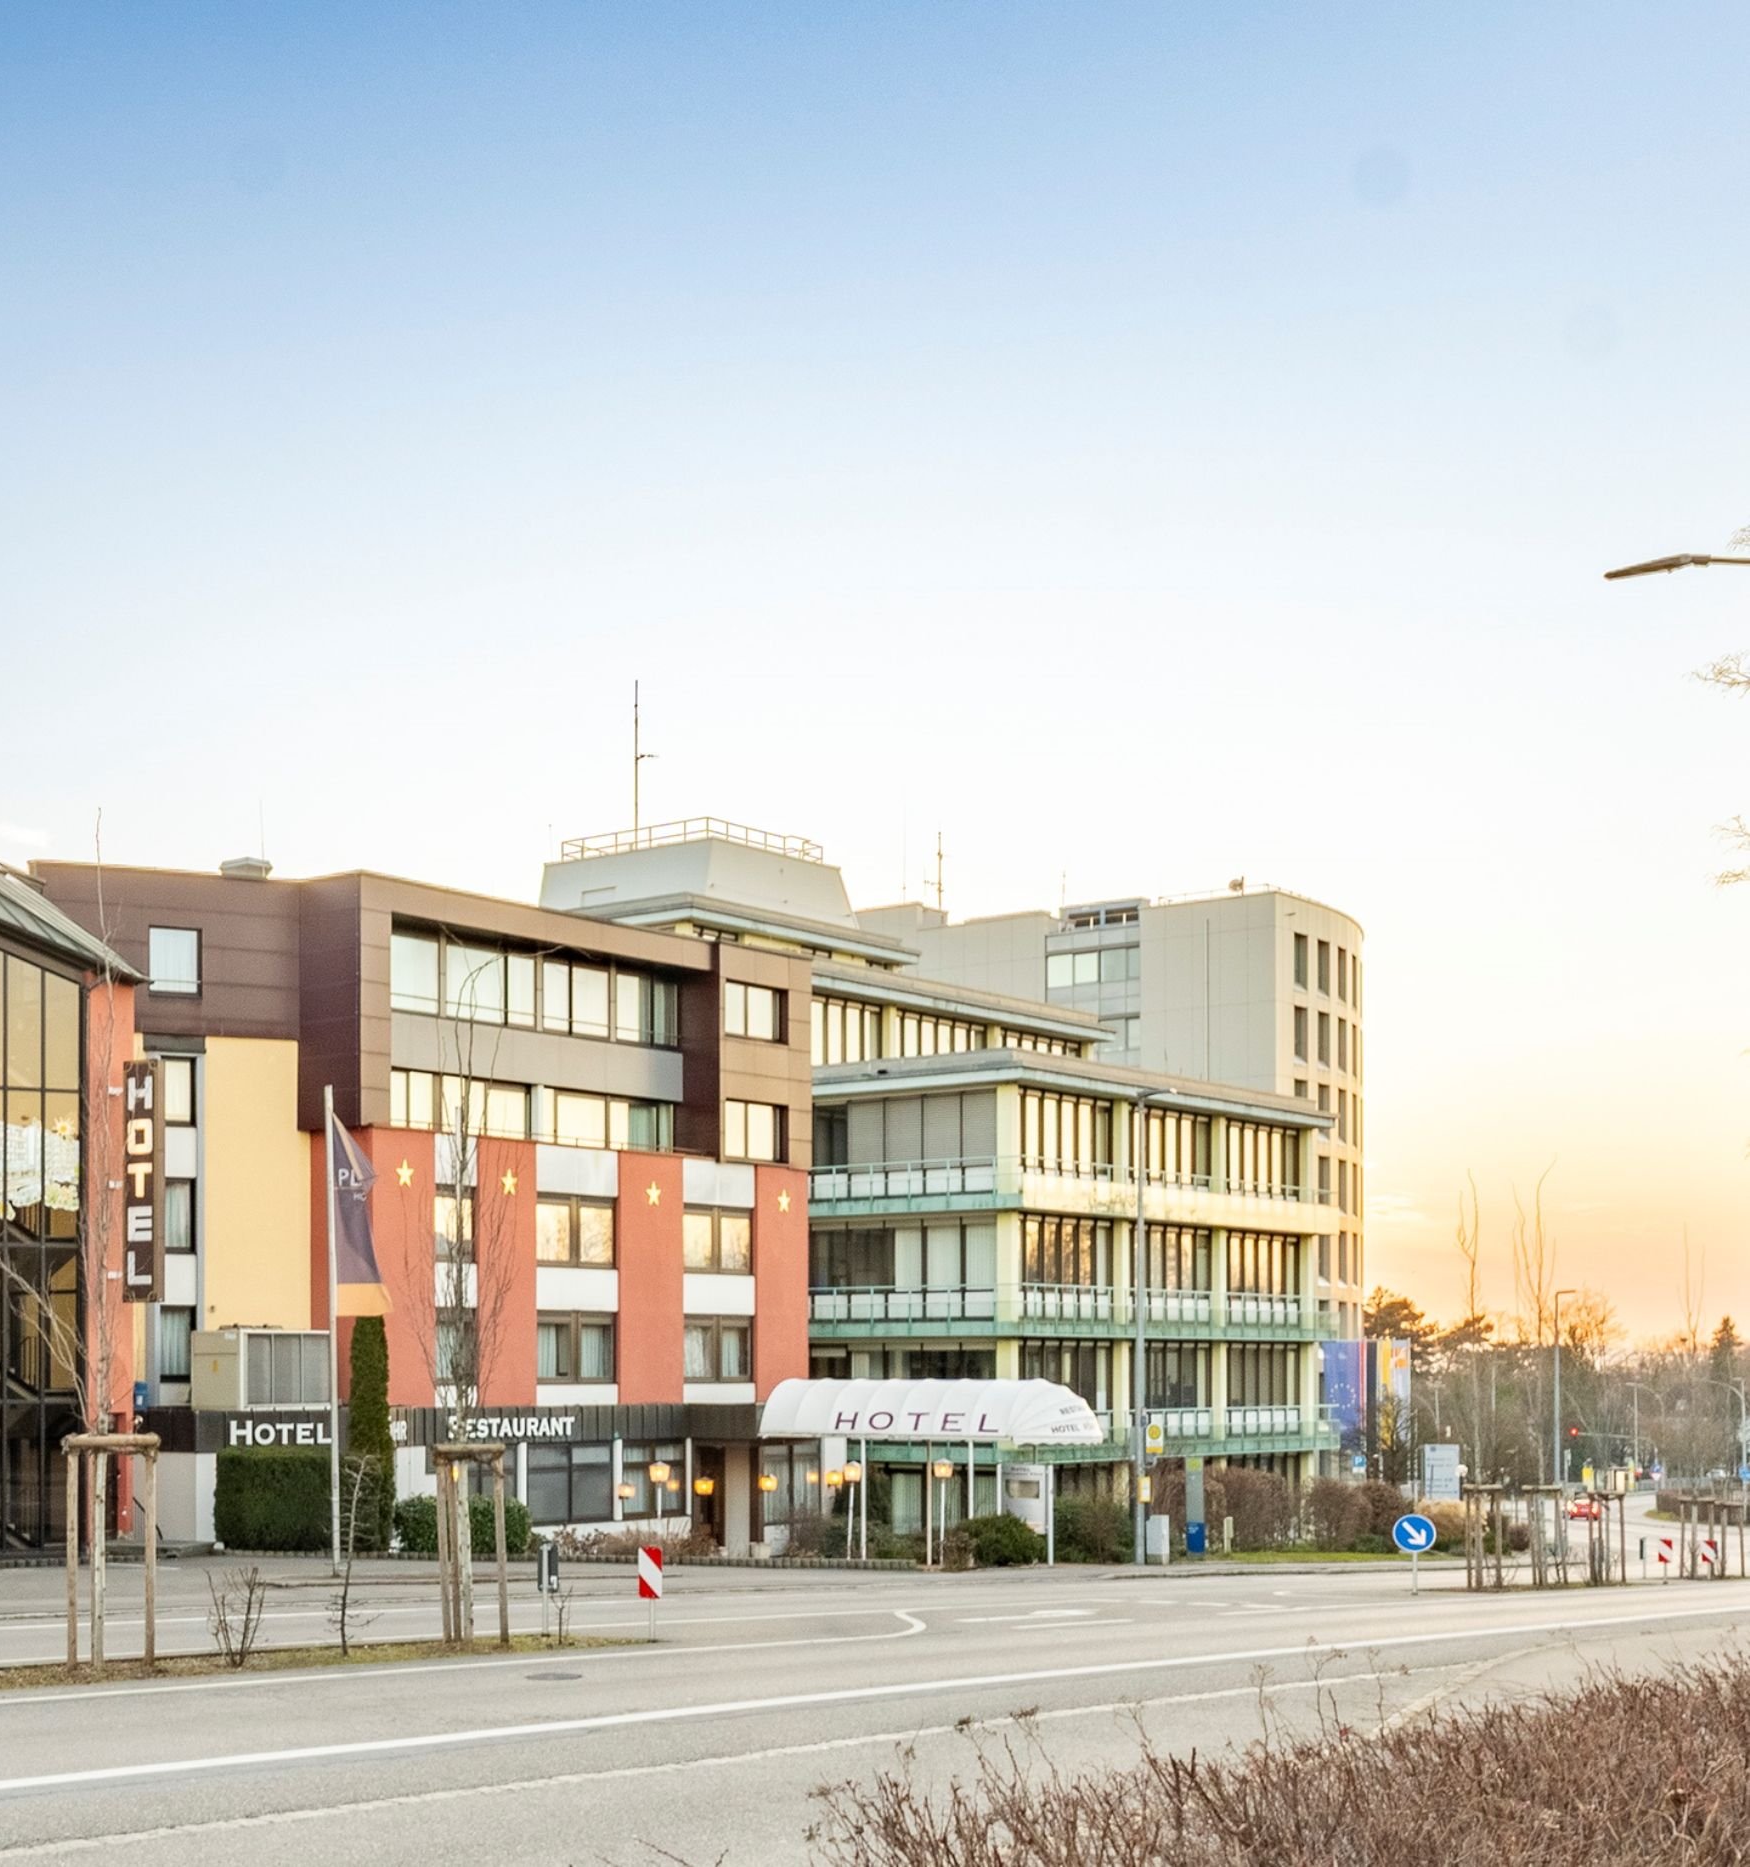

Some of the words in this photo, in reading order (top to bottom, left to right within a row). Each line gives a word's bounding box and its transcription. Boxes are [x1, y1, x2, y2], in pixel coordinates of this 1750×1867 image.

[127, 1075, 153, 1286] HOTEL
[229, 1420, 332, 1446] HOTEL
[834, 1411, 999, 1433] HOTEL
[1050, 1423, 1081, 1434] HOTEL
